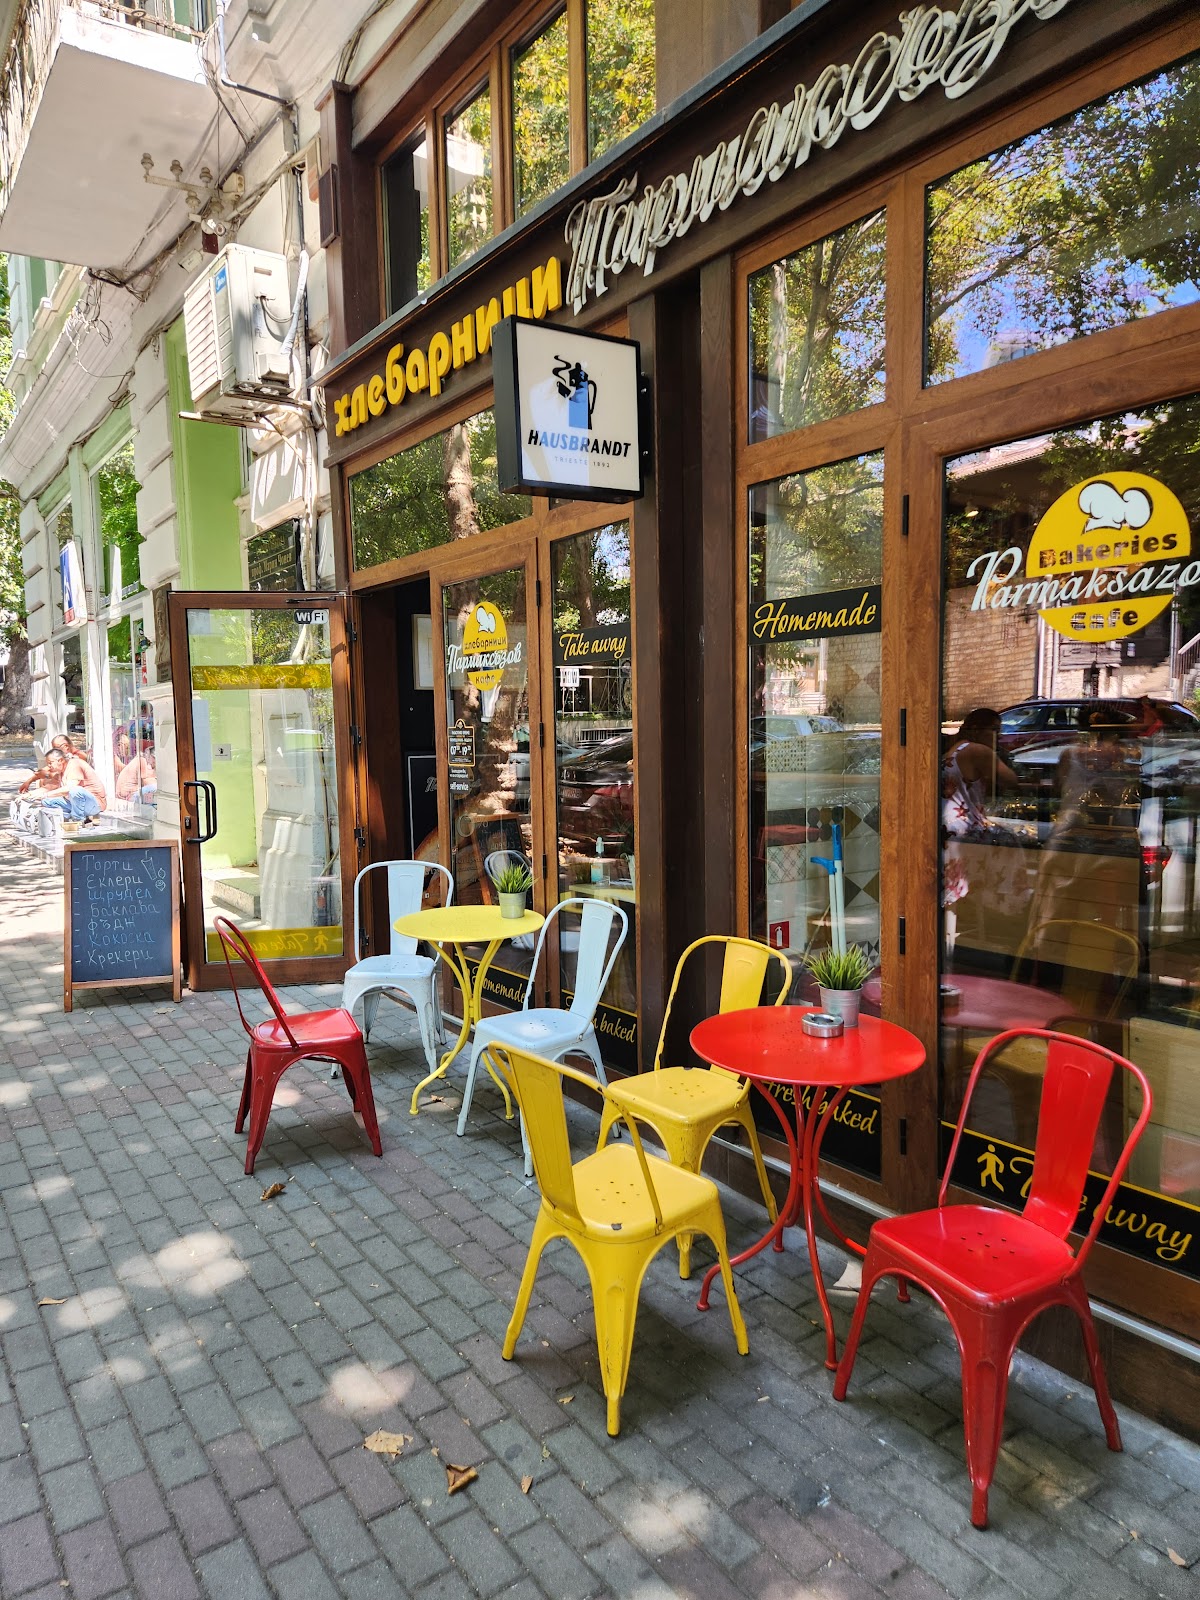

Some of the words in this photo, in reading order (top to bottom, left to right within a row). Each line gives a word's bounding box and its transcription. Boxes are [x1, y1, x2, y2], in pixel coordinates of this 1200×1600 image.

[334, 256, 562, 437] хлебарници
[527, 429, 631, 457] HAUSBRANDT
[555, 456, 588, 466] TRIESTE
[1039, 533, 1178, 569] Bakeries
[753, 592, 877, 638] Homemade
[1070, 608, 1139, 631] Cafe
[464, 636, 507, 650] хлебарници
[559, 633, 590, 661] Take
[591, 636, 627, 659] away
[475, 673, 495, 685] кафе
[82, 855, 133, 876] Торти
[86, 874, 143, 890] Еклери
[87, 949, 153, 969] Крекери
[600, 1013, 637, 1043] baked
